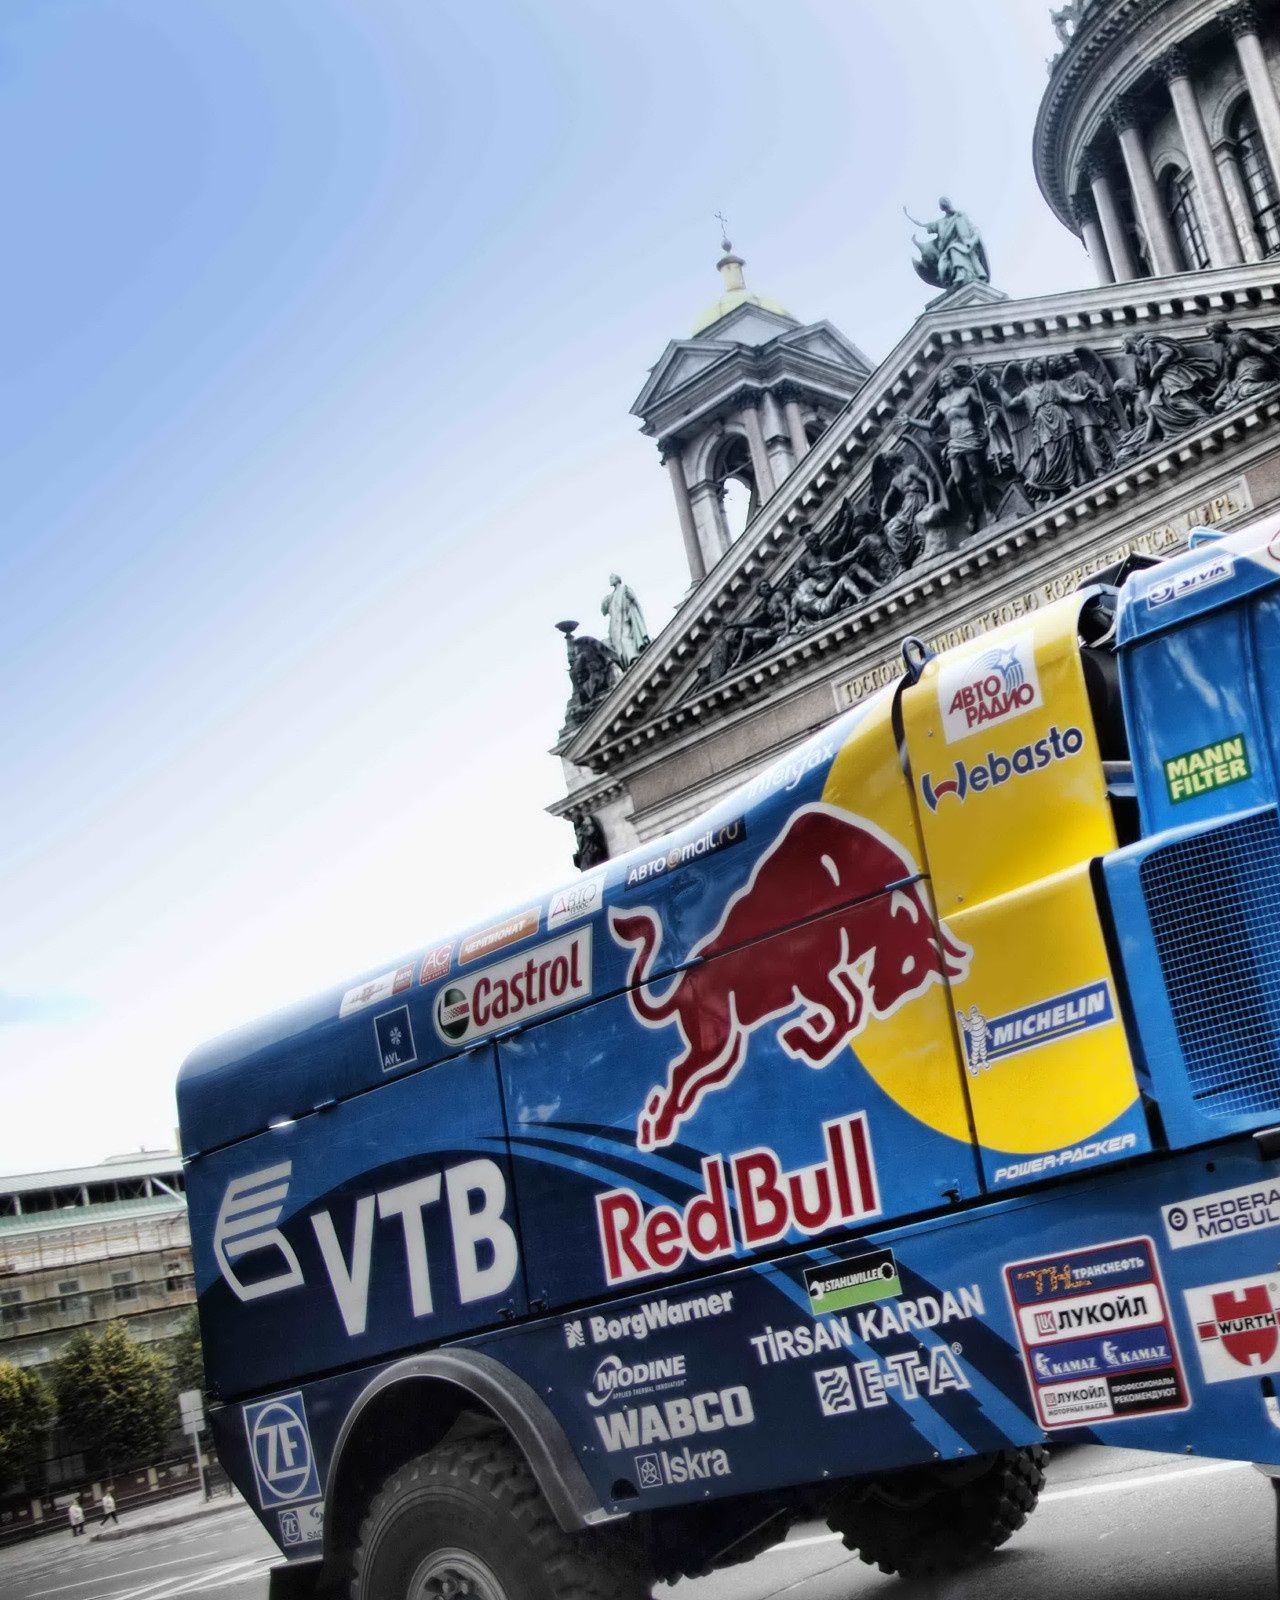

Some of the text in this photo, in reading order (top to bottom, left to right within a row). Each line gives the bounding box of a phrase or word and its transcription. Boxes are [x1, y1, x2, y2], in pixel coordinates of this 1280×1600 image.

[949, 675, 1001, 715] АВТО
[965, 683, 1034, 728] РАДИО
[921, 725, 1084, 815] Webasto
[1167, 738, 1243, 781] MANN
[1170, 759, 1247, 800] FILTER
[472, 940, 583, 1027] Castrol
[993, 990, 1106, 1047] MICHELIN
[384, 1052, 401, 1067] AVL
[994, 1133, 1136, 1183] POWER-PACKER
[598, 1114, 878, 1282] Red Bull
[1197, 1208, 1280, 1239] MOGUL
[310, 1158, 519, 1337] VTB
[1072, 1257, 1145, 1280] ТРАНСНЕФТЬ
[825, 1269, 881, 1292] STAHLWILLE
[589, 1290, 733, 1343] BorgWarner
[857, 1284, 986, 1343] KARDAN
[1058, 1295, 1148, 1330] ЛУКОЙЛ
[1052, 1345, 1167, 1375] KAMAZ KAMAZ
[1058, 1385, 1106, 1404] ЛУКОЙЛ
[1114, 1387, 1177, 1404] РЕКОМЕНДУЮТ
[595, 1385, 755, 1453] WABCO
[255, 1419, 309, 1482] ZF
[661, 1447, 732, 1485] Iskra
